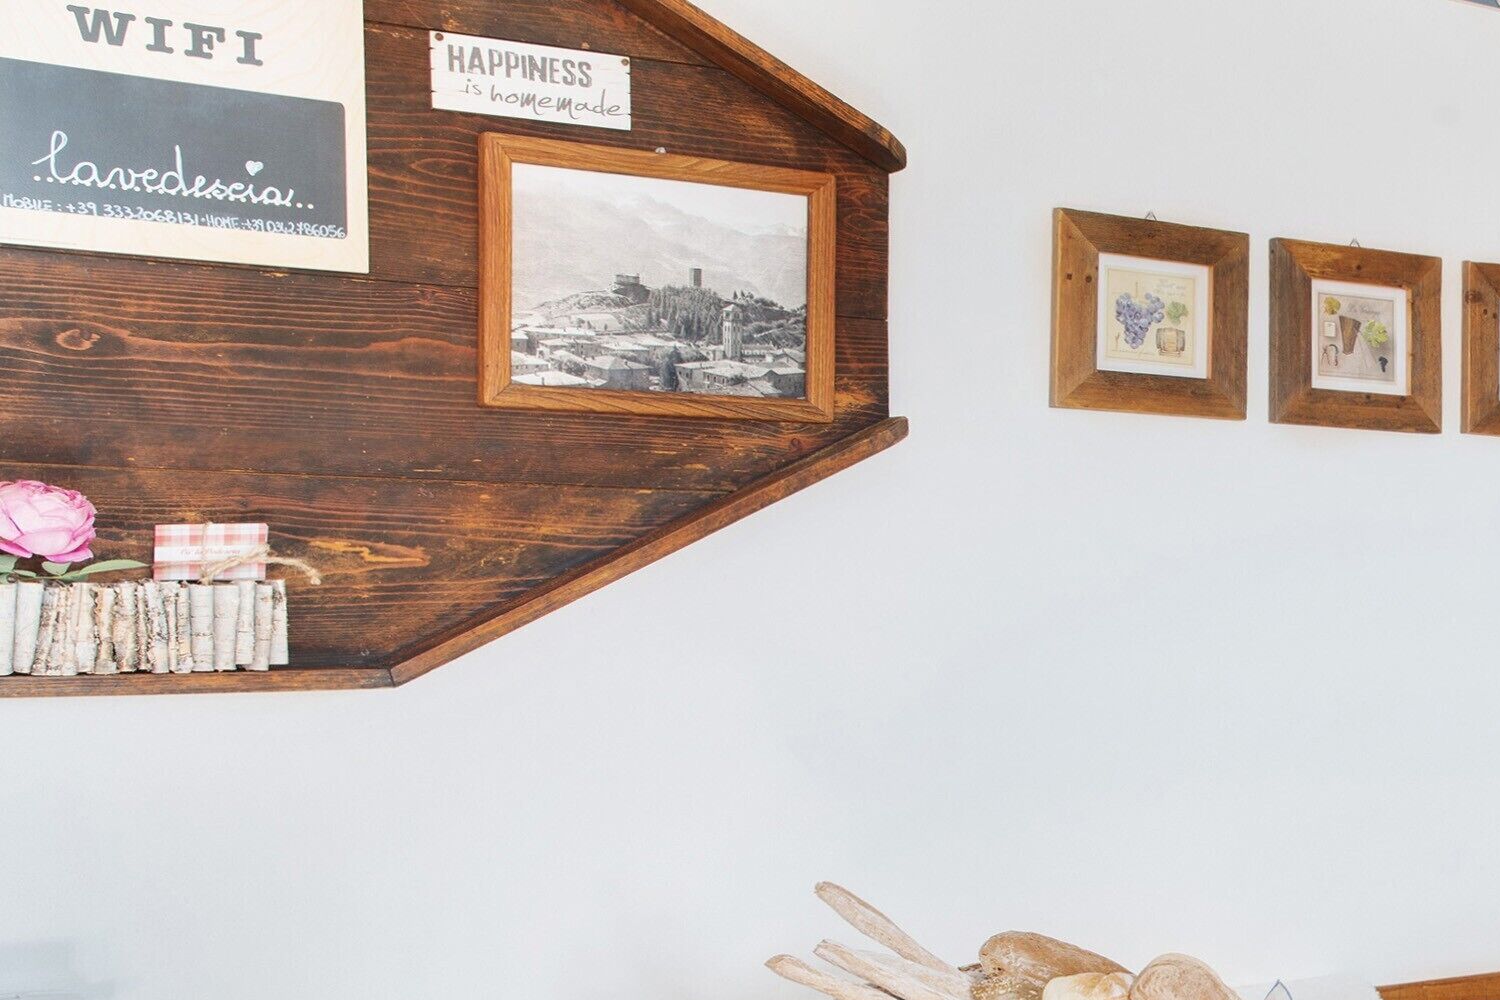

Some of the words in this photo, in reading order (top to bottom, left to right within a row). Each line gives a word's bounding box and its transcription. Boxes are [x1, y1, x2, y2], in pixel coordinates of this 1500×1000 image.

[66, 4, 263, 66] WIFI
[447, 44, 592, 88] HAPPINESS
[459, 78, 482, 96] is
[490, 84, 625, 119] homemade
